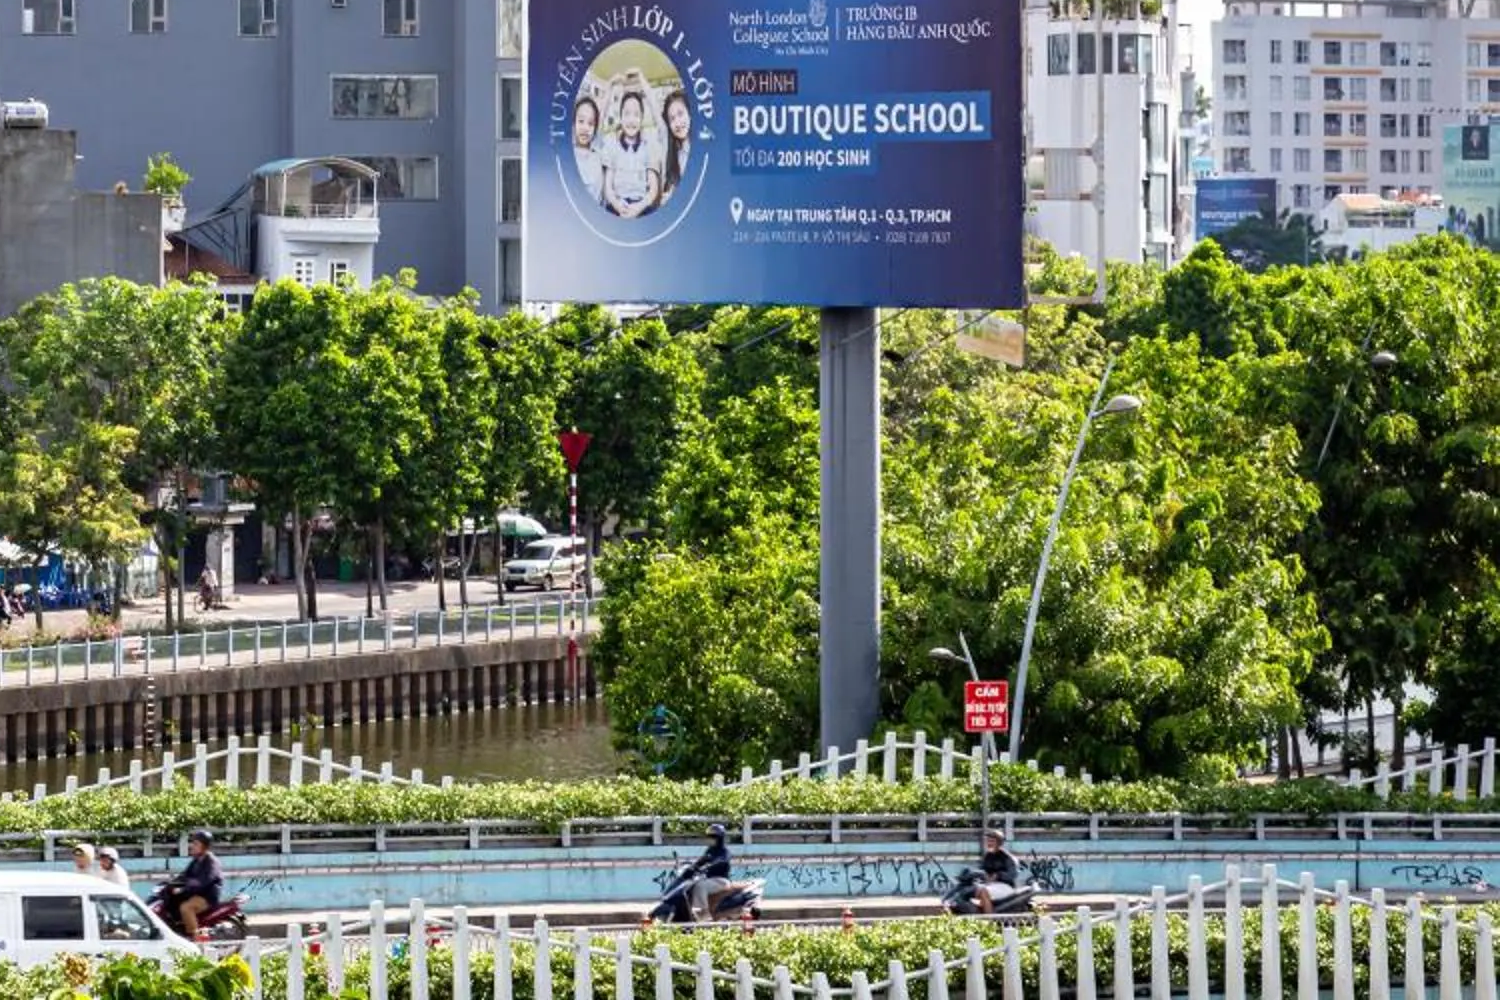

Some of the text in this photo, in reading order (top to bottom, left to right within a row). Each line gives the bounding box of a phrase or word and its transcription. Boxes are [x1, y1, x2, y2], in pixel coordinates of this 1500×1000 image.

[729, 8, 808, 26] North London
[905, 6, 918, 21] IB
[733, 25, 829, 48] Collegiate School
[846, 22, 885, 41] HÀNG
[918, 23, 948, 39] ANH
[950, 18, 992, 43] QUỐC
[581, 5, 627, 50] SINH
[633, 4, 673, 38] LỚP
[687, 58, 714, 119] LỚP
[733, 71, 795, 93] MÔ HÌNH
[733, 101, 984, 141] BOUTIQUE SCHOOL
[777, 150, 801, 167] 200
[804, 150, 834, 171] HỌC
[837, 149, 870, 166] SINH
[747, 209, 774, 222] NGAY
[776, 209, 793, 225] TẠI
[794, 209, 832, 222] TRUNG
[834, 206, 857, 222] TÂM
[910, 209, 951, 222] TP.HCM
